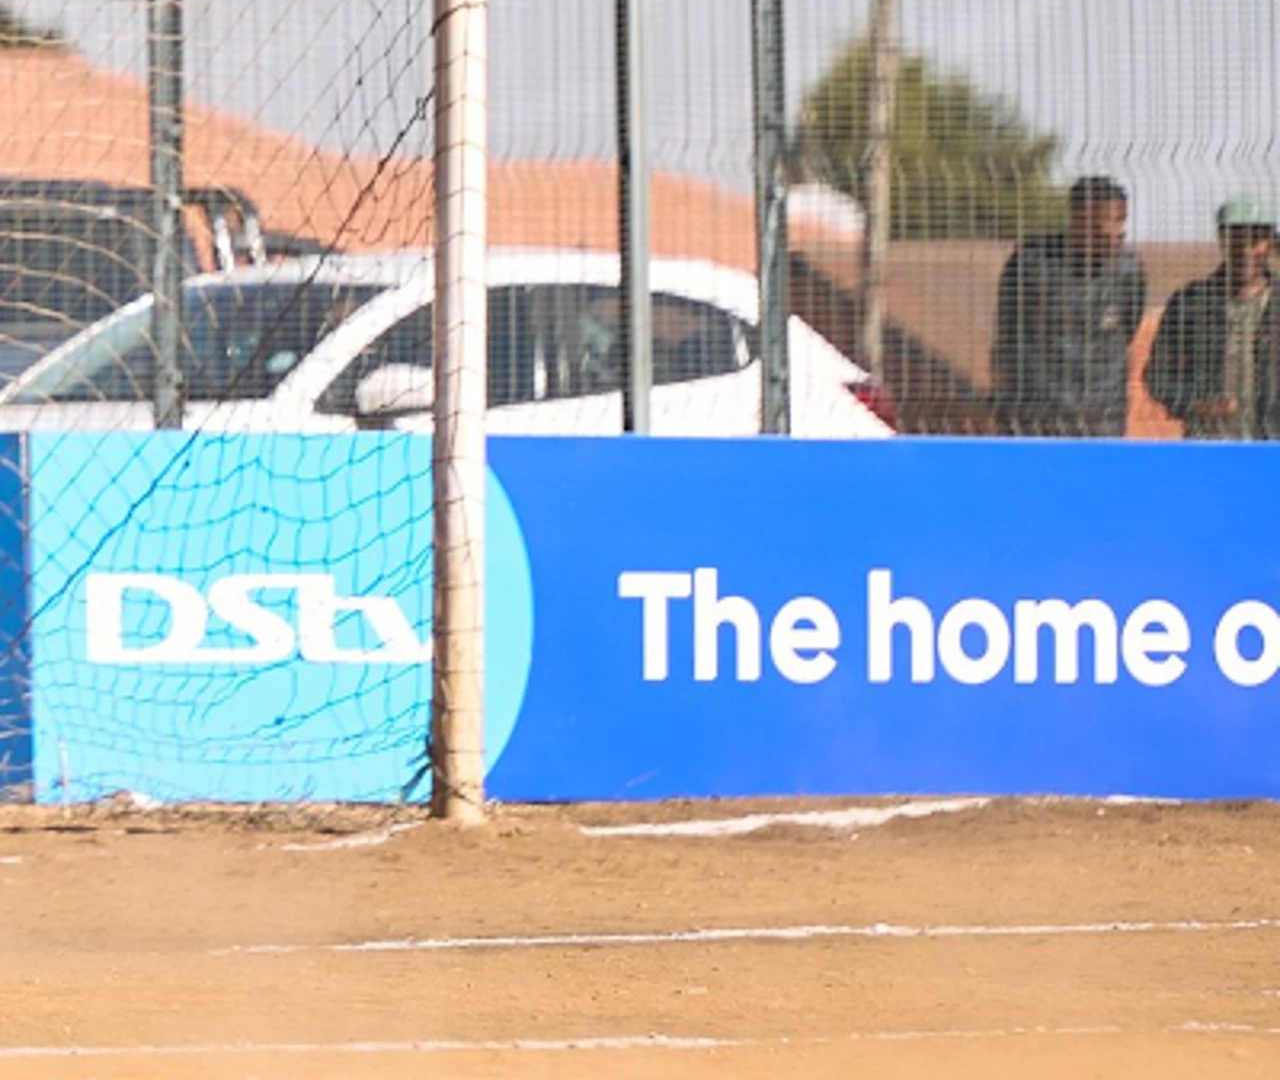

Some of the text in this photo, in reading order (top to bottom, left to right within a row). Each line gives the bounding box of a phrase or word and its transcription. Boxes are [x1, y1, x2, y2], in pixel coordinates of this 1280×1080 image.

[618, 567, 1280, 687] The home o
